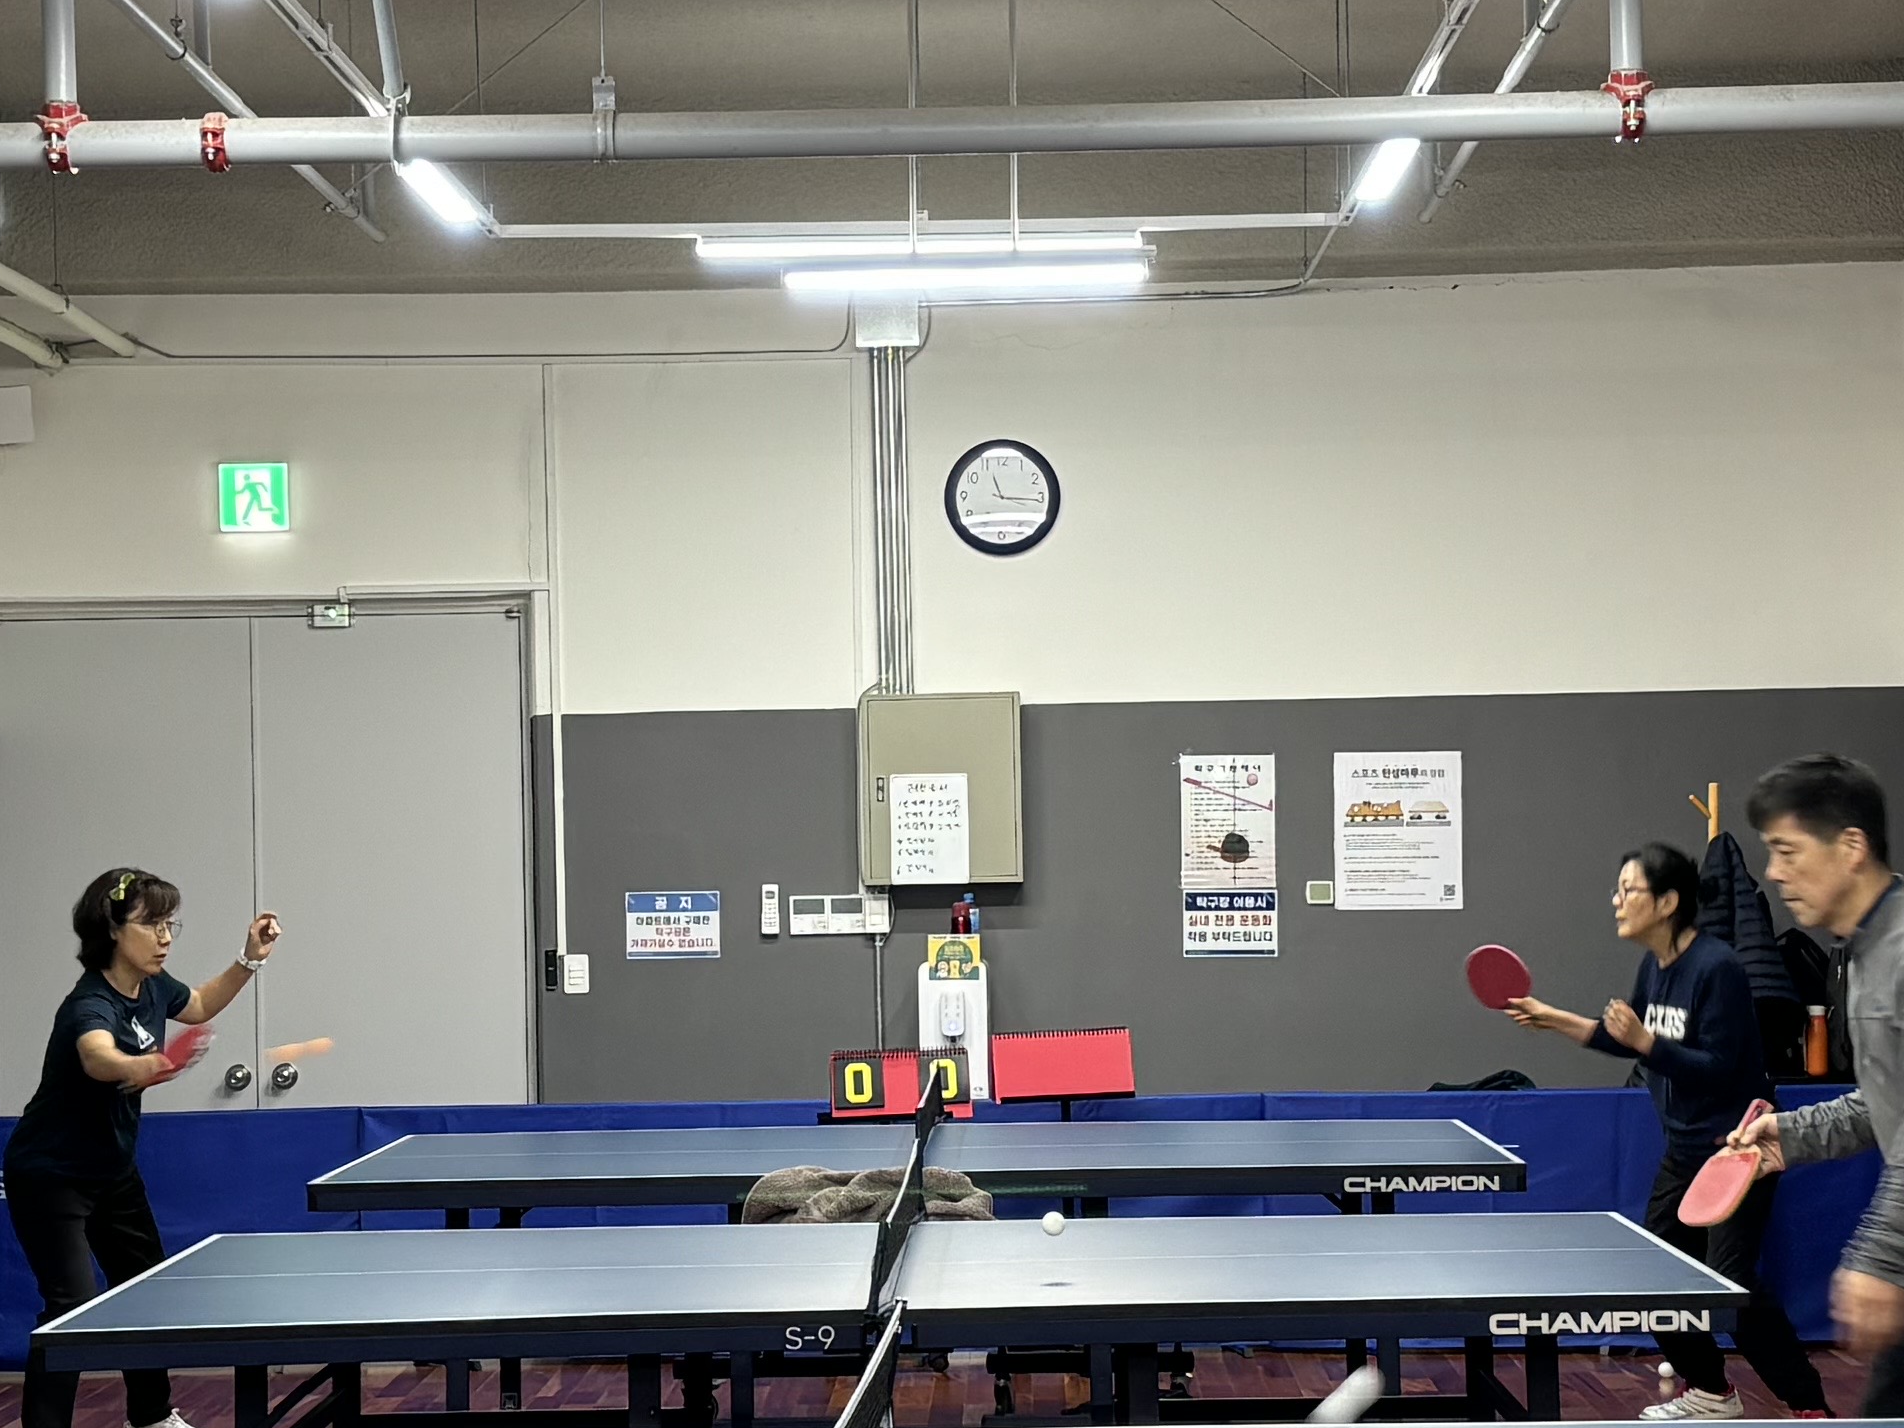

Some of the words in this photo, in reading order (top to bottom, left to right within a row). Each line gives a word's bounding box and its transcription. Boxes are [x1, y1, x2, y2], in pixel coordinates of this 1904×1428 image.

[967, 471, 979, 484] 10
[1031, 472, 1039, 485] 2
[959, 490, 968, 503] 9
[1036, 491, 1045, 504] 3
[844, 1062, 873, 1104] 0
[1343, 1175, 1500, 1193] CHAMPION
[1488, 1309, 1711, 1335] CHAMPION
[785, 1325, 835, 1350] S-9
